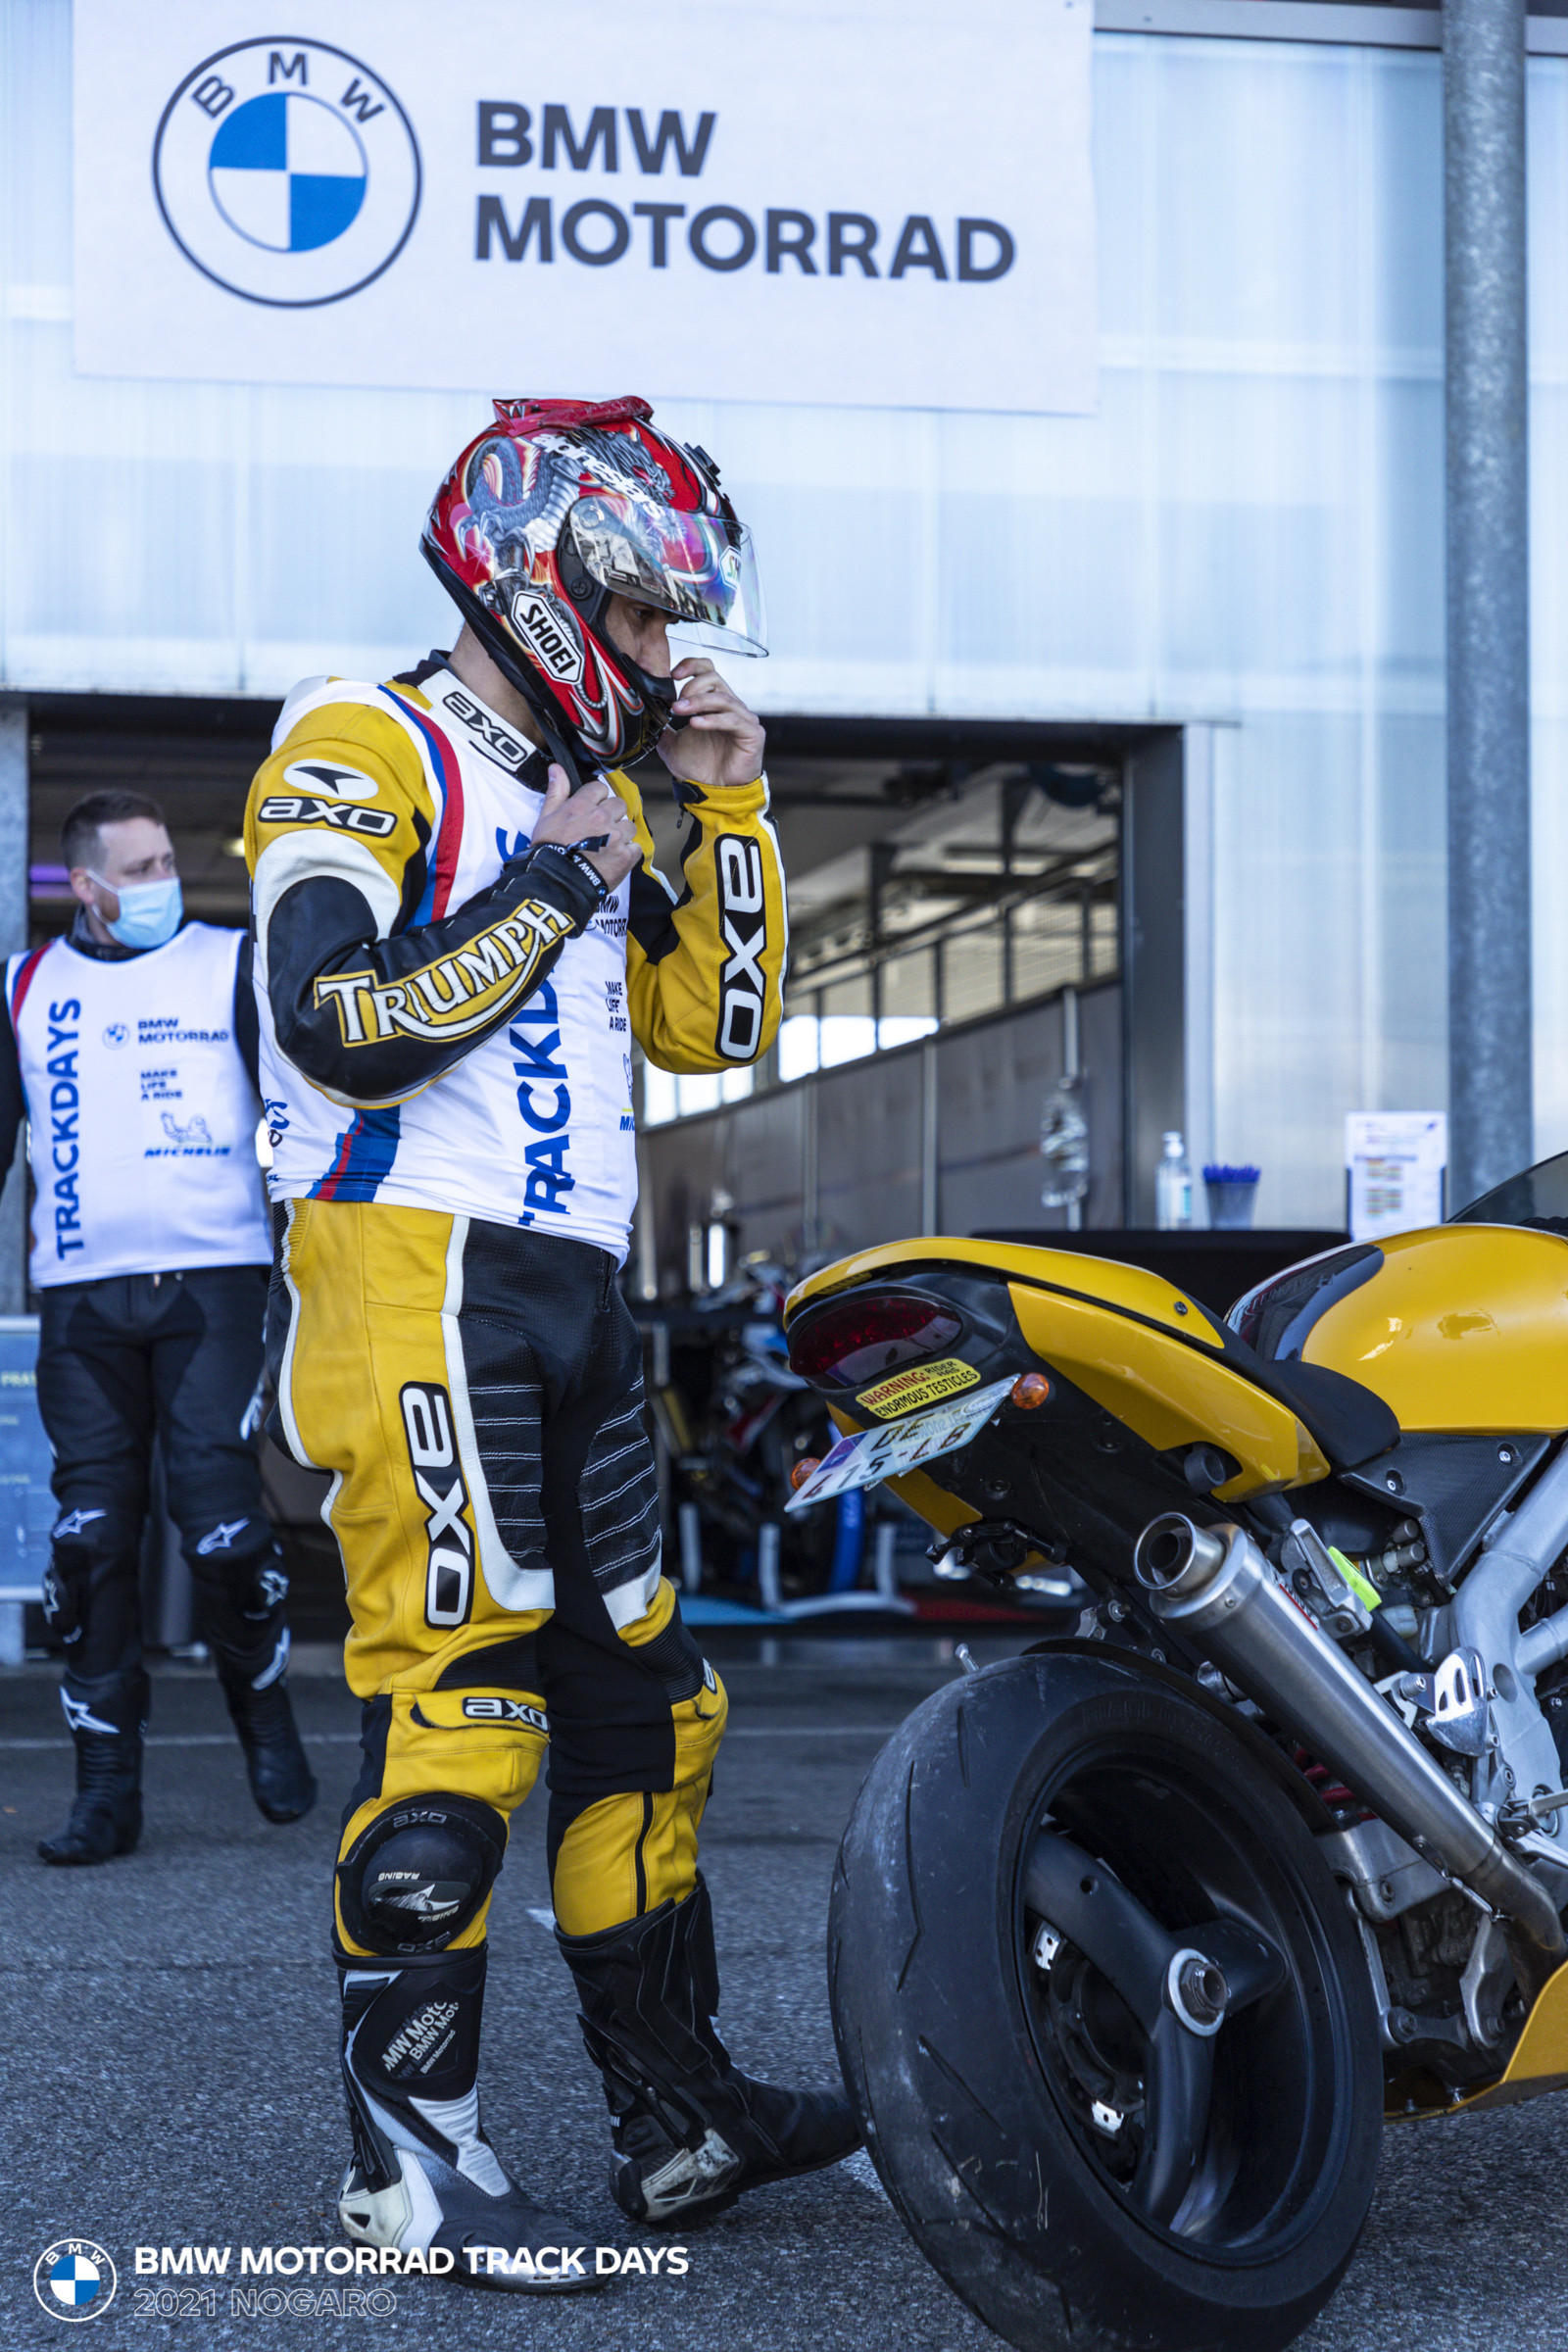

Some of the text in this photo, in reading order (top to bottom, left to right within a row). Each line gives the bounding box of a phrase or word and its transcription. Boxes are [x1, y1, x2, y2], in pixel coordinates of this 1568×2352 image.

[189, 51, 385, 124] BMW
[475, 100, 717, 176] BMW
[474, 195, 1016, 283] MOTORRAD
[518, 603, 577, 675] SHOEI
[578, 862, 601, 887] BMW
[317, 899, 571, 1042] TRIUMPH
[138, 1017, 178, 1029] BMW
[138, 1030, 229, 1044] MOTORRAD
[46, 998, 84, 1261] TRACKDAYS
[859, 1360, 957, 1405] WARNING: RIDER
[874, 1388, 929, 1417] ENORMOUS
[926, 1370, 978, 1396] TESTICLES
[409, 2027, 439, 2060] BMW
[419, 2030, 457, 2075] BMW Motorrad
